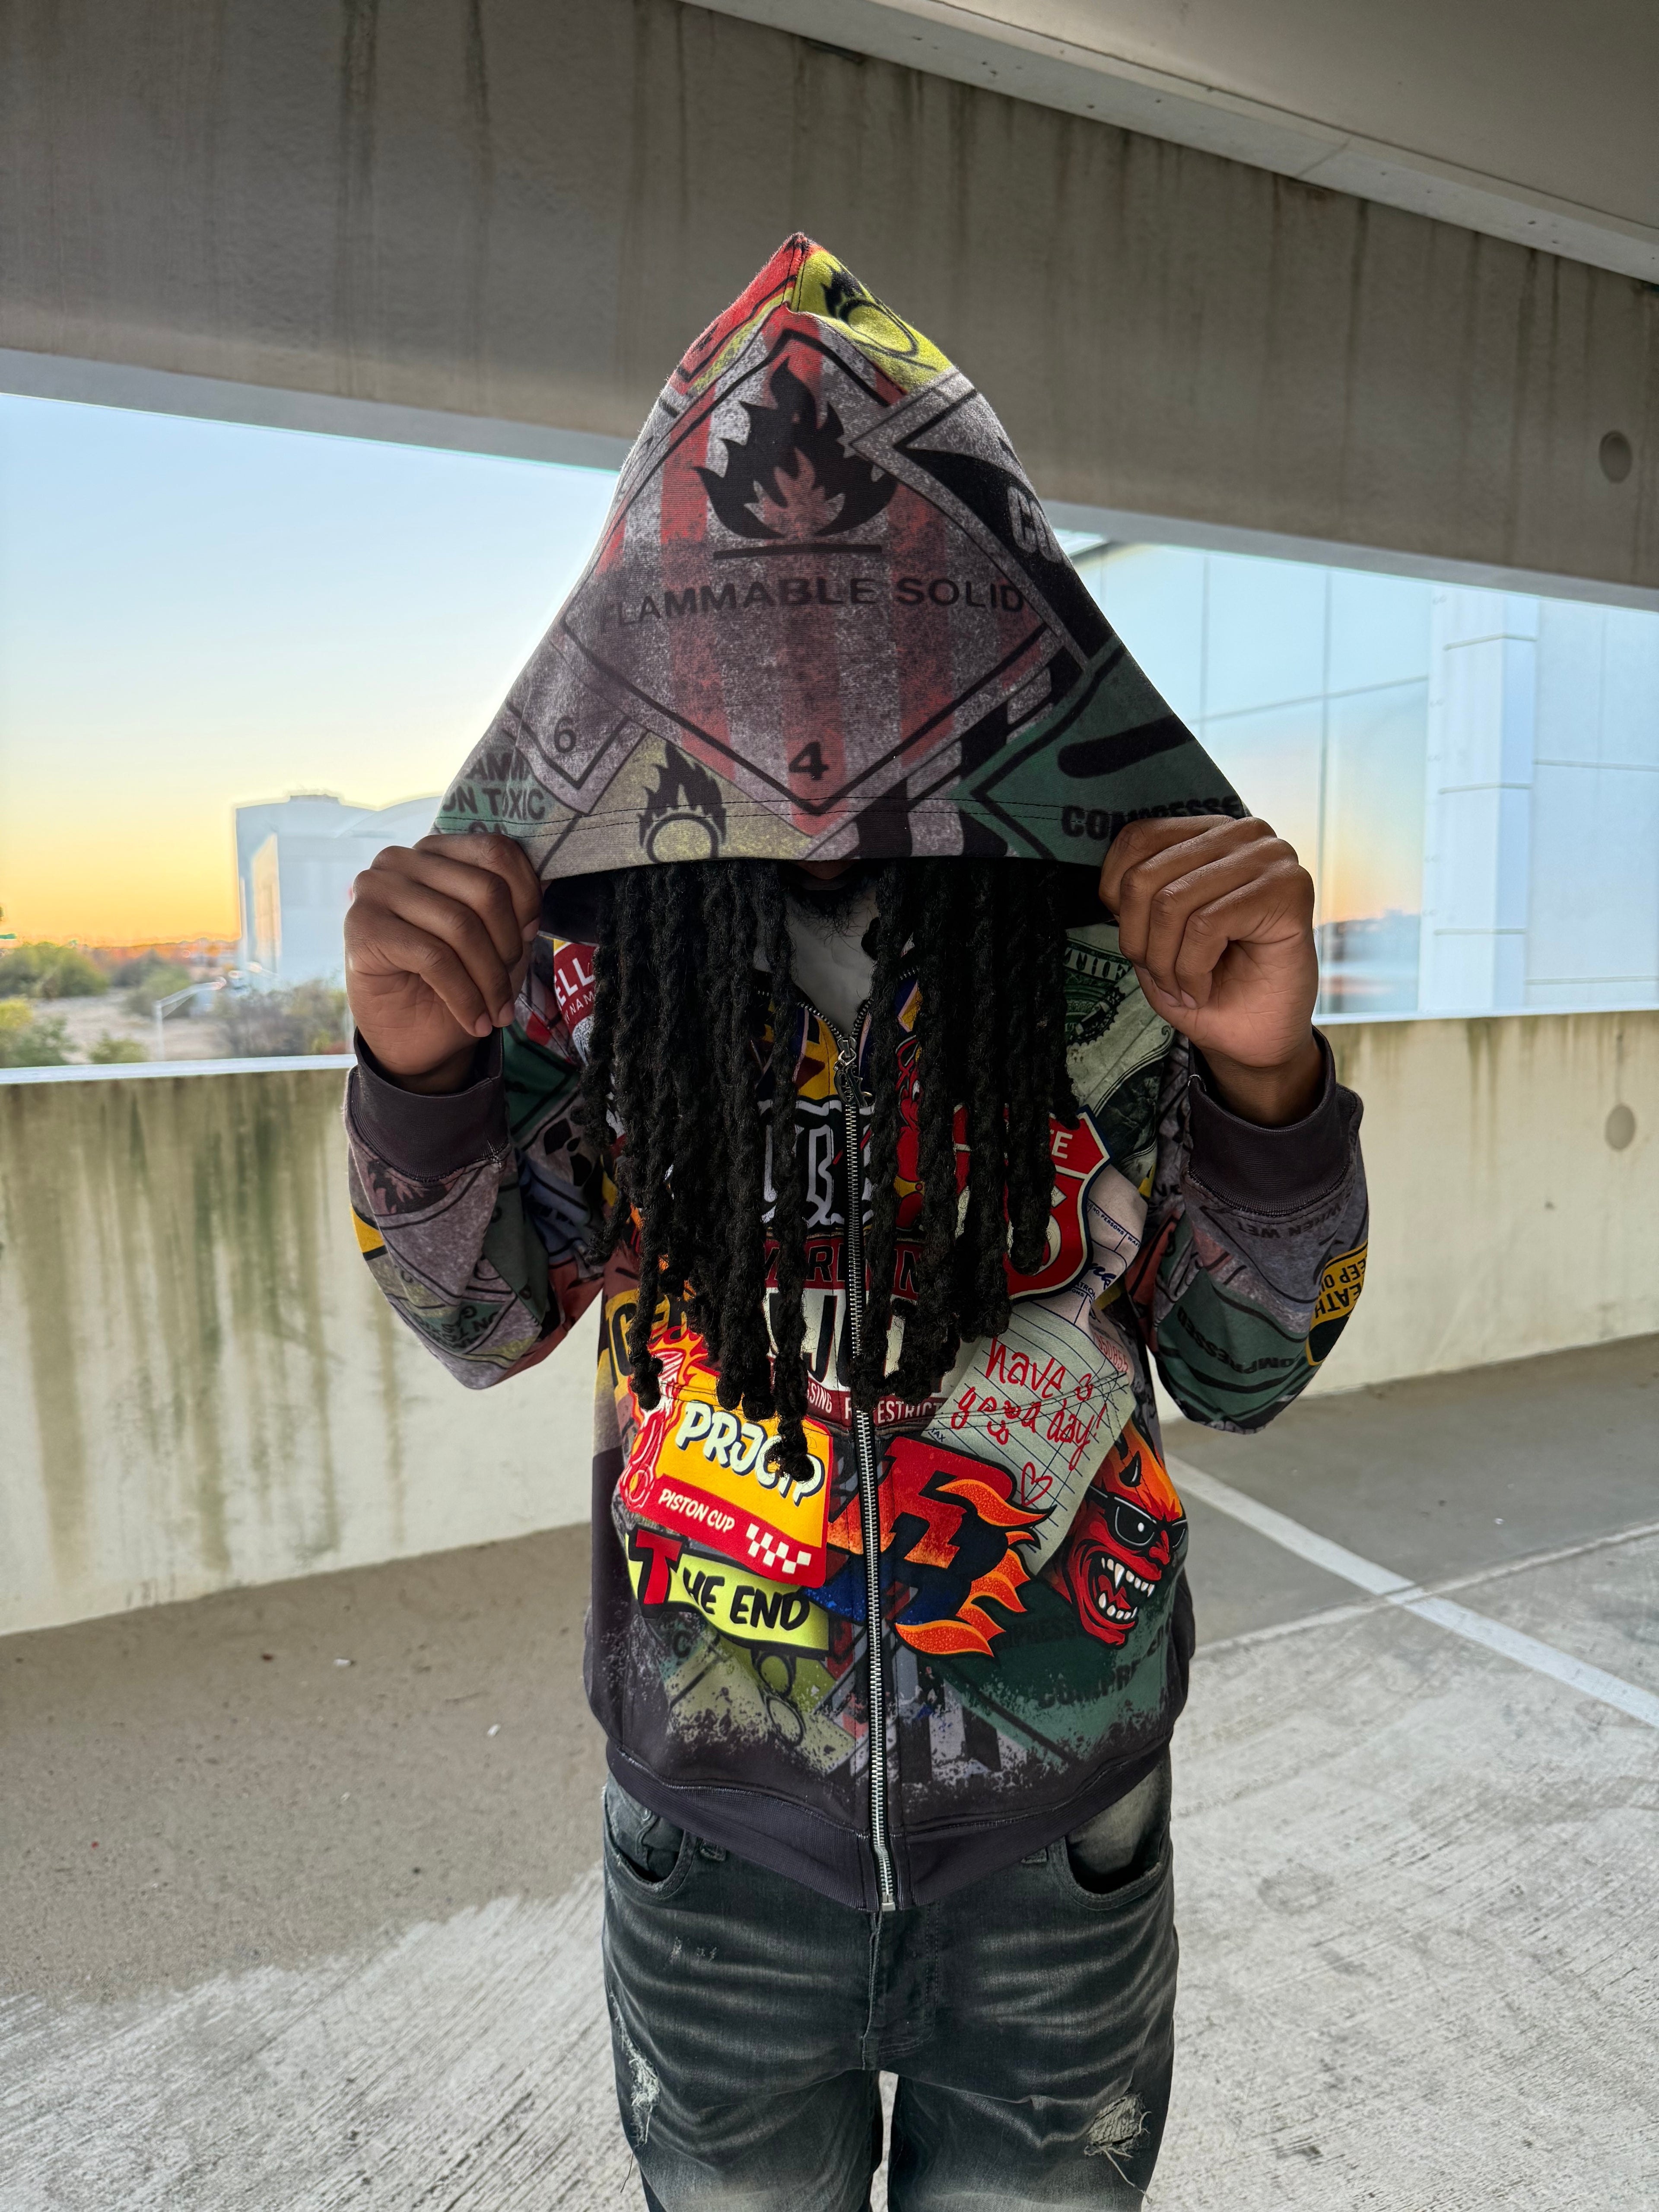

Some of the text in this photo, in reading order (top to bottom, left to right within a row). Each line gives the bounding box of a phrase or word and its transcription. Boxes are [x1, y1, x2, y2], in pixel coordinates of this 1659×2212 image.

[895, 577, 1023, 613] SOLID
[553, 716, 577, 753] 6
[788, 741, 829, 779] 4
[1101, 1214, 1125, 1235] PERSONS
[658, 1488, 735, 1533] PISTON CUP
[629, 1525, 810, 1630] THE END
